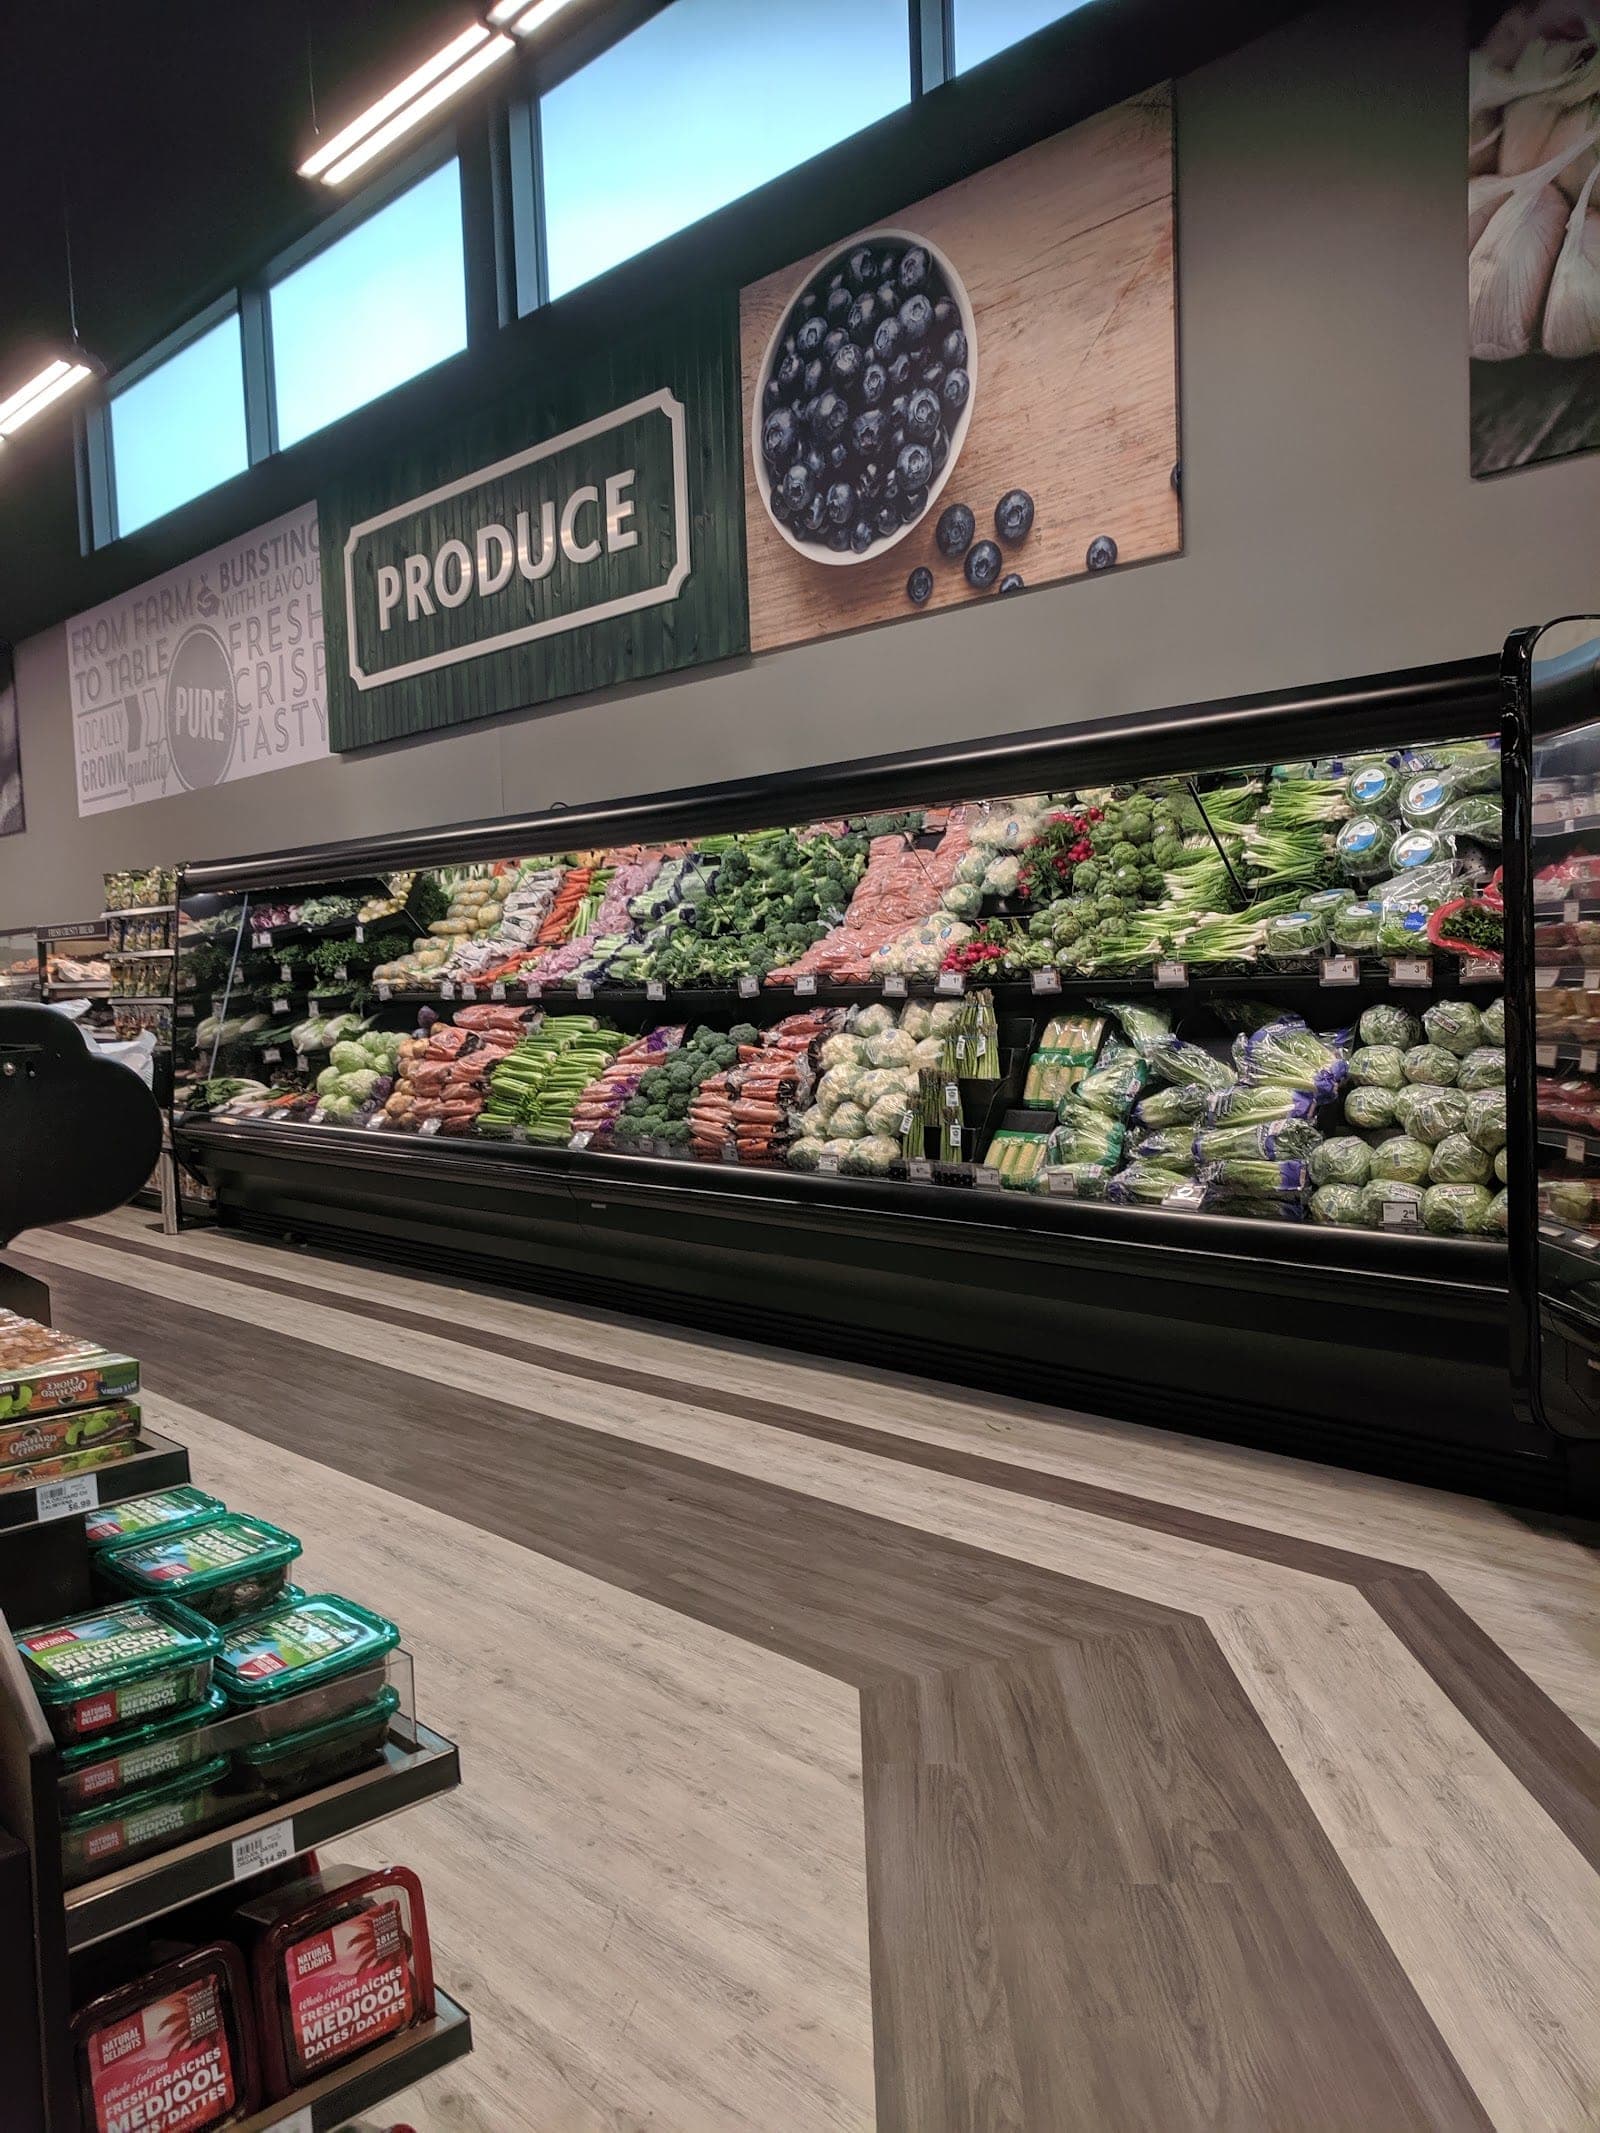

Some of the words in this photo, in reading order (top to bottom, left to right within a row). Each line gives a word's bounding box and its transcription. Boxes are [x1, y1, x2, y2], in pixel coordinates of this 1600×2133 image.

[377, 468, 639, 632] PRODUCE
[222, 586, 256, 619] WITH
[71, 609, 127, 667] FROM
[133, 577, 193, 640] FARM
[75, 666, 100, 708] TO
[105, 637, 169, 695] TABLE
[175, 686, 226, 742] PURE
[237, 697, 328, 763] TASTY
[81, 750, 126, 792] GROWN
[10, 1434, 57, 1455] ORCHARD
[18, 1442, 52, 1457] CHOICE
[123, 1750, 180, 1775] MEDJOOL
[128, 1811, 184, 1838] MEDJOOL
[259, 1849, 287, 1867] $14.99
[296, 1943, 331, 1967] NATURAL
[298, 1952, 333, 1975] DELIGHTS
[302, 1979, 406, 2045] MEDJOOL
[101, 2027, 141, 2053] NATURAL
[102, 2037, 142, 2065] DELIGHTS
[107, 2063, 226, 2133] MEDJOOL
